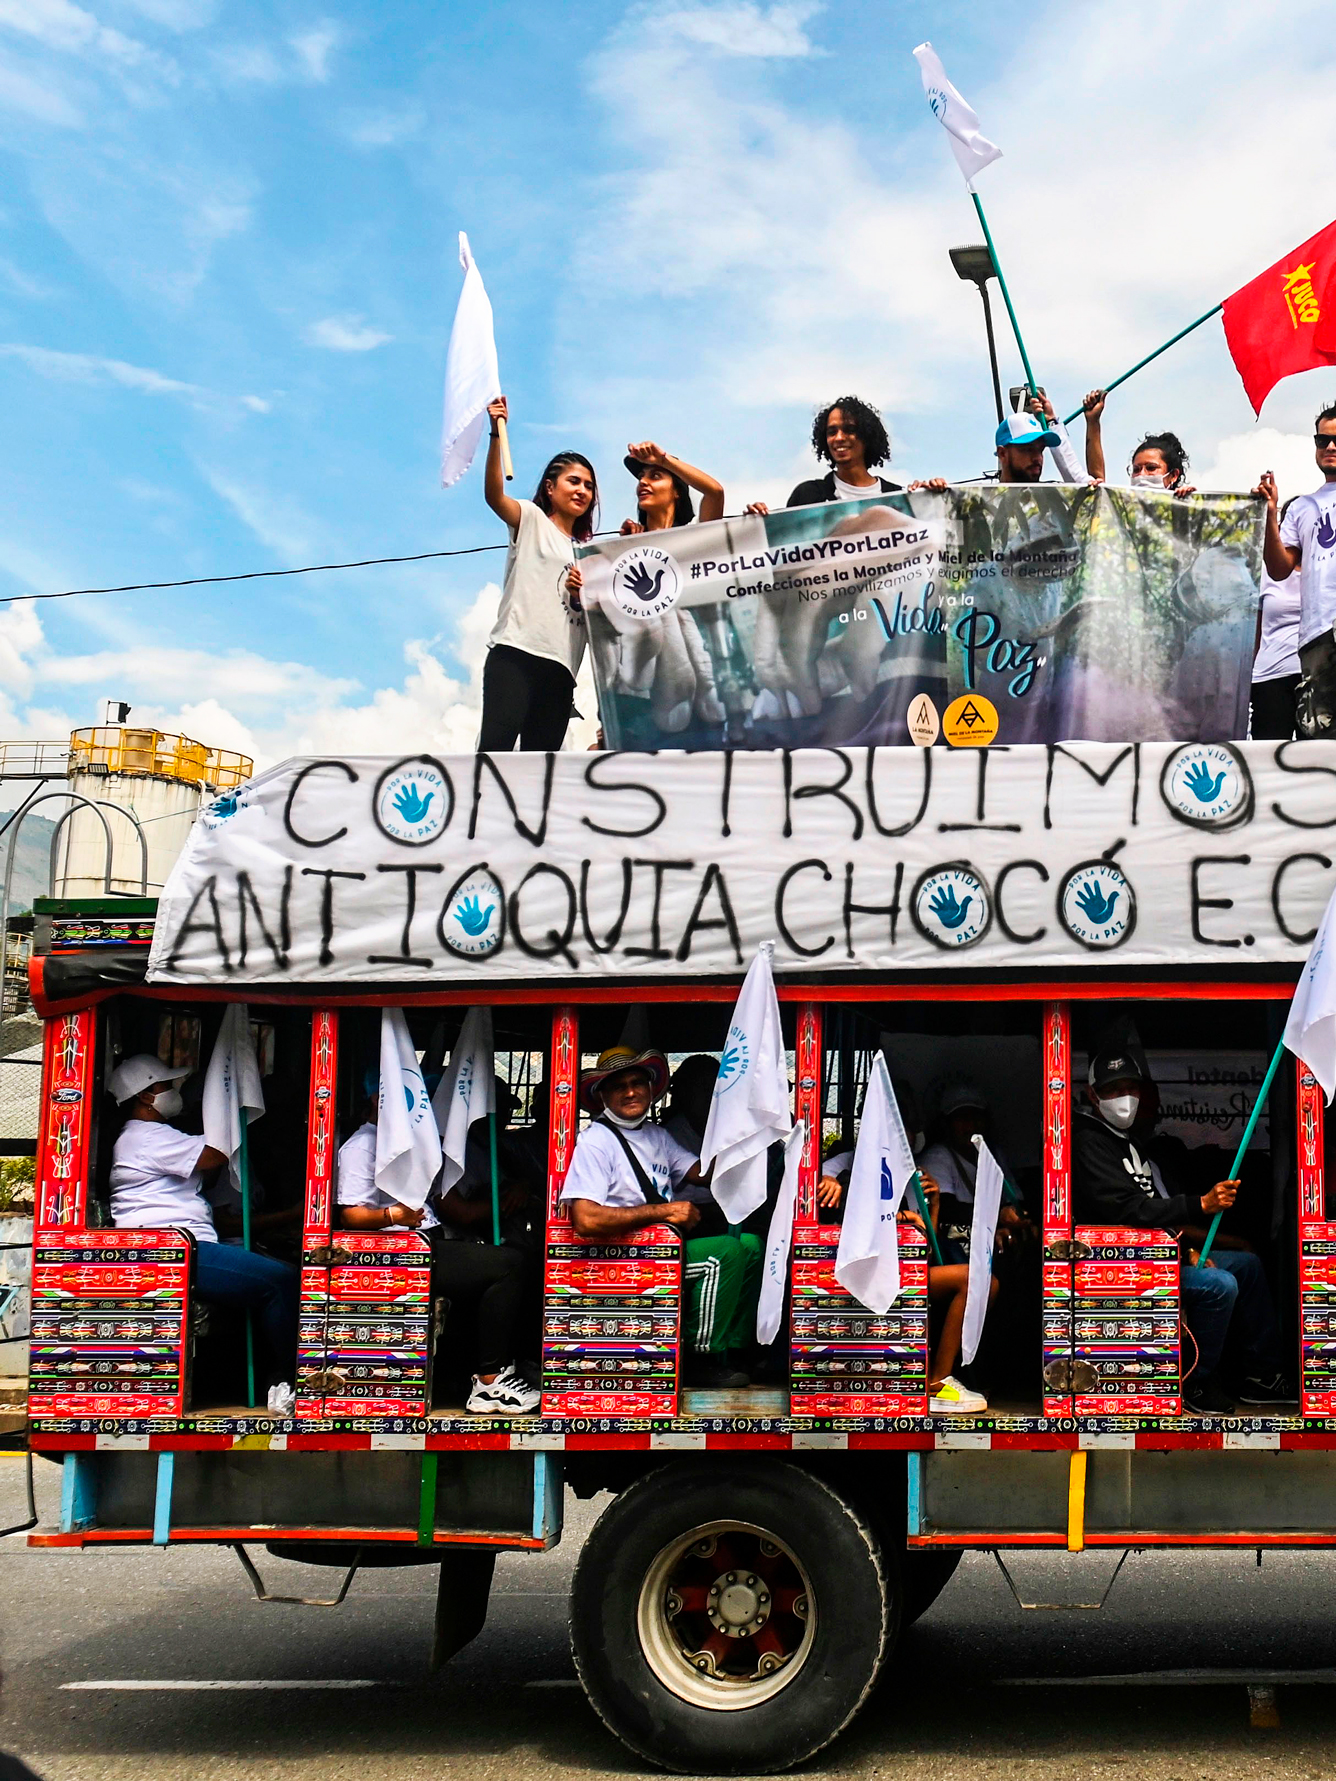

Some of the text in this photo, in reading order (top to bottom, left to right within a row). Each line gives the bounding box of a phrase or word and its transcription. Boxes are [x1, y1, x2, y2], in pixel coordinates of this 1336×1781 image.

[1291, 281, 1321, 323] JUCO
[614, 548, 669, 573] POR LA VIDA
[690, 529, 929, 579] #PorLaVidaYPorLaPaz
[726, 547, 1078, 598] Confecciones la Montaña y Miel de la Montaña
[798, 565, 1076, 603] Nos movilizamos y exigimos el derecho
[622, 604, 638, 616] POR
[654, 595, 674, 613] PAZ
[947, 596, 957, 607] a
[961, 594, 975, 606] la
[838, 581, 944, 643] a la Vida
[952, 606, 1038, 698] Paz
[1208, 748, 1233, 767] VIDA
[417, 769, 442, 788] VIDA
[1211, 799, 1232, 816] PAZ
[386, 823, 400, 835] POR
[417, 819, 438, 837] PAZ
[923, 879, 937, 892] POR
[954, 870, 980, 892] VIDA
[1069, 866, 1127, 888] POR LA VIDA
[164, 857, 746, 971] ANTIOQUIA
[775, 839, 1138, 958] CHOCÓ
[956, 925, 978, 943] PAZ
[1071, 923, 1086, 937] POR
[1104, 920, 1125, 938] PAZ
[56, 1090, 77, 1102] Ford
[458, 1080, 466, 1096] POR
